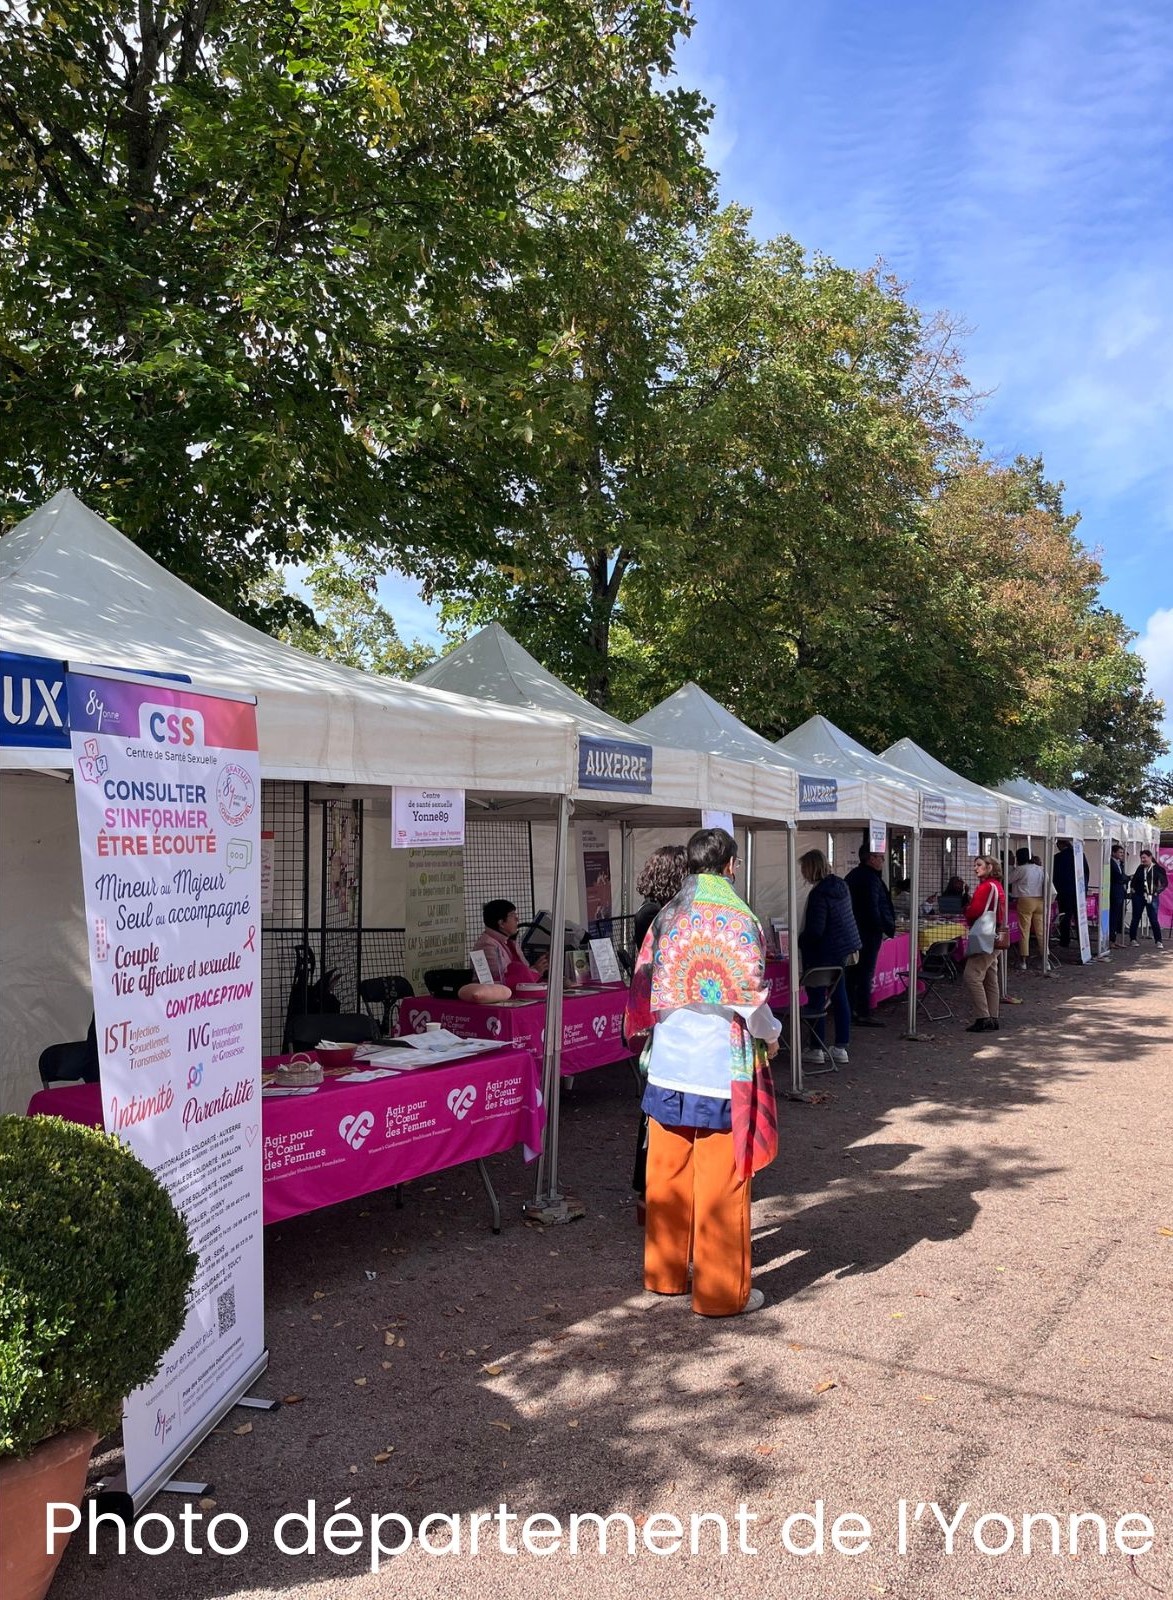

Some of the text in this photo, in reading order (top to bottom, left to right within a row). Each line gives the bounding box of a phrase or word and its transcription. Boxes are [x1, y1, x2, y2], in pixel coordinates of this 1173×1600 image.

[3, 674, 70, 728] UX
[150, 711, 195, 746] CSS
[126, 747, 218, 765] Centre de Santé Sexuelle
[585, 749, 647, 781] AUXERRE
[104, 779, 207, 803] CONSULTER
[422, 791, 441, 799] Centre
[801, 783, 836, 803] AUXERRE
[408, 800, 415, 808] de
[432, 800, 453, 808] sexuelle
[105, 807, 208, 829] S'INFORMER
[412, 811, 450, 823] Yonne89
[97, 828, 216, 857] ÊTRE ÉCOUTÉ
[95, 869, 226, 901] Mineur ou Majeur
[116, 895, 250, 931] Seul ou accompagné
[115, 942, 160, 971] Couple
[112, 952, 242, 997] Vie affective et sexuelle
[166, 982, 254, 1019] CONTRACEPTION
[104, 1021, 160, 1055] IST Infections
[129, 1034, 170, 1056] Sexuellement
[187, 1022, 243, 1052] IVG Interruption
[212, 1035, 241, 1050] Volontaire
[129, 1049, 172, 1070] Transmissibles
[211, 1045, 245, 1064] de Grossesse
[485, 1077, 522, 1092] Agir pour
[485, 1088, 517, 1101] le Cœur
[110, 1080, 175, 1133] Intimité
[182, 1078, 255, 1133] Parentalité
[386, 1100, 428, 1118] Agir pour
[485, 1100, 498, 1111] des
[385, 1118, 437, 1138] des Femmes
[386, 1112, 420, 1128] le Cœur
[264, 1128, 315, 1148] Agir pour
[184, 1148, 191, 1157] DE
[221, 1144, 241, 1160] AVALLON
[264, 1142, 306, 1160] le Cœur
[264, 1148, 327, 1171] des Femmes
[166, 1359, 179, 1377] Pour
[179, 1352, 187, 1364] en
[187, 1338, 202, 1357] savoir
